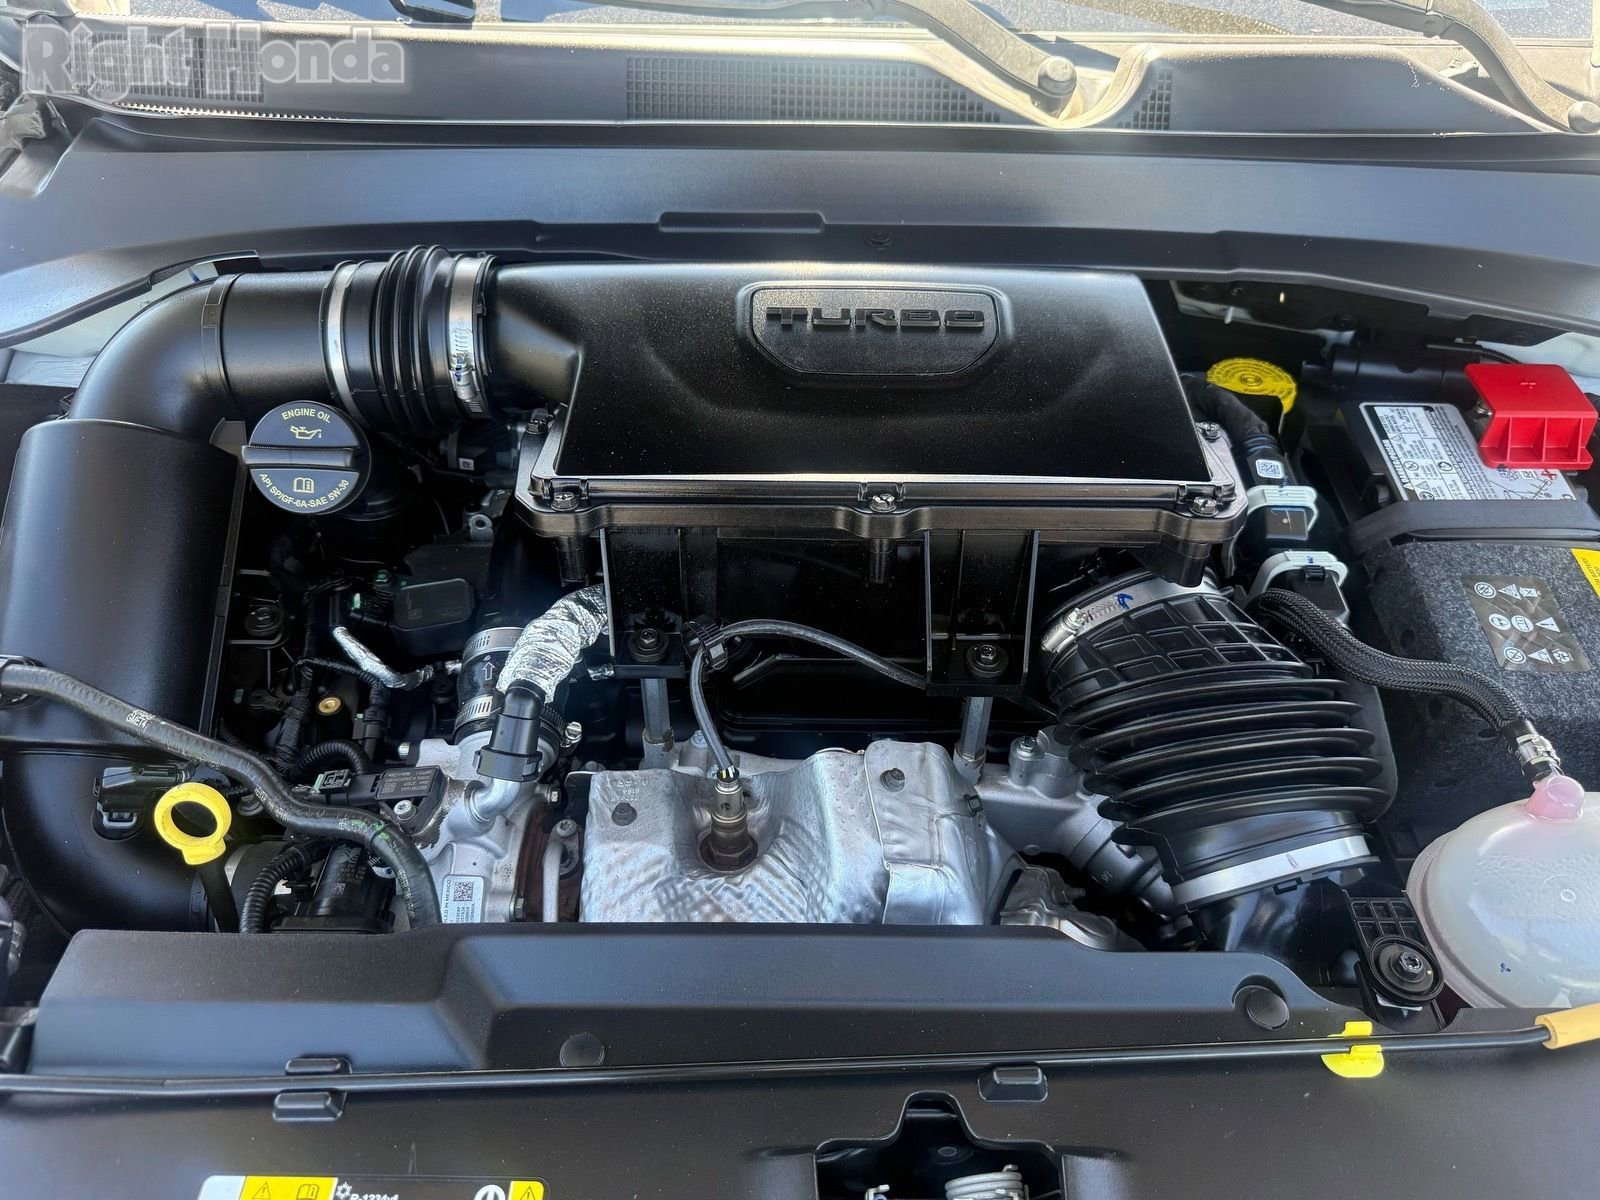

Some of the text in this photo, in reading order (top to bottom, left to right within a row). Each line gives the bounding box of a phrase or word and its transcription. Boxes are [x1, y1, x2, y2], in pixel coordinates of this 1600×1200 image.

[766, 307, 985, 328] TURBO
[281, 407, 332, 423] ENGINE OIL
[259, 473, 272, 488] API
[328, 479, 350, 501] 5W-30
